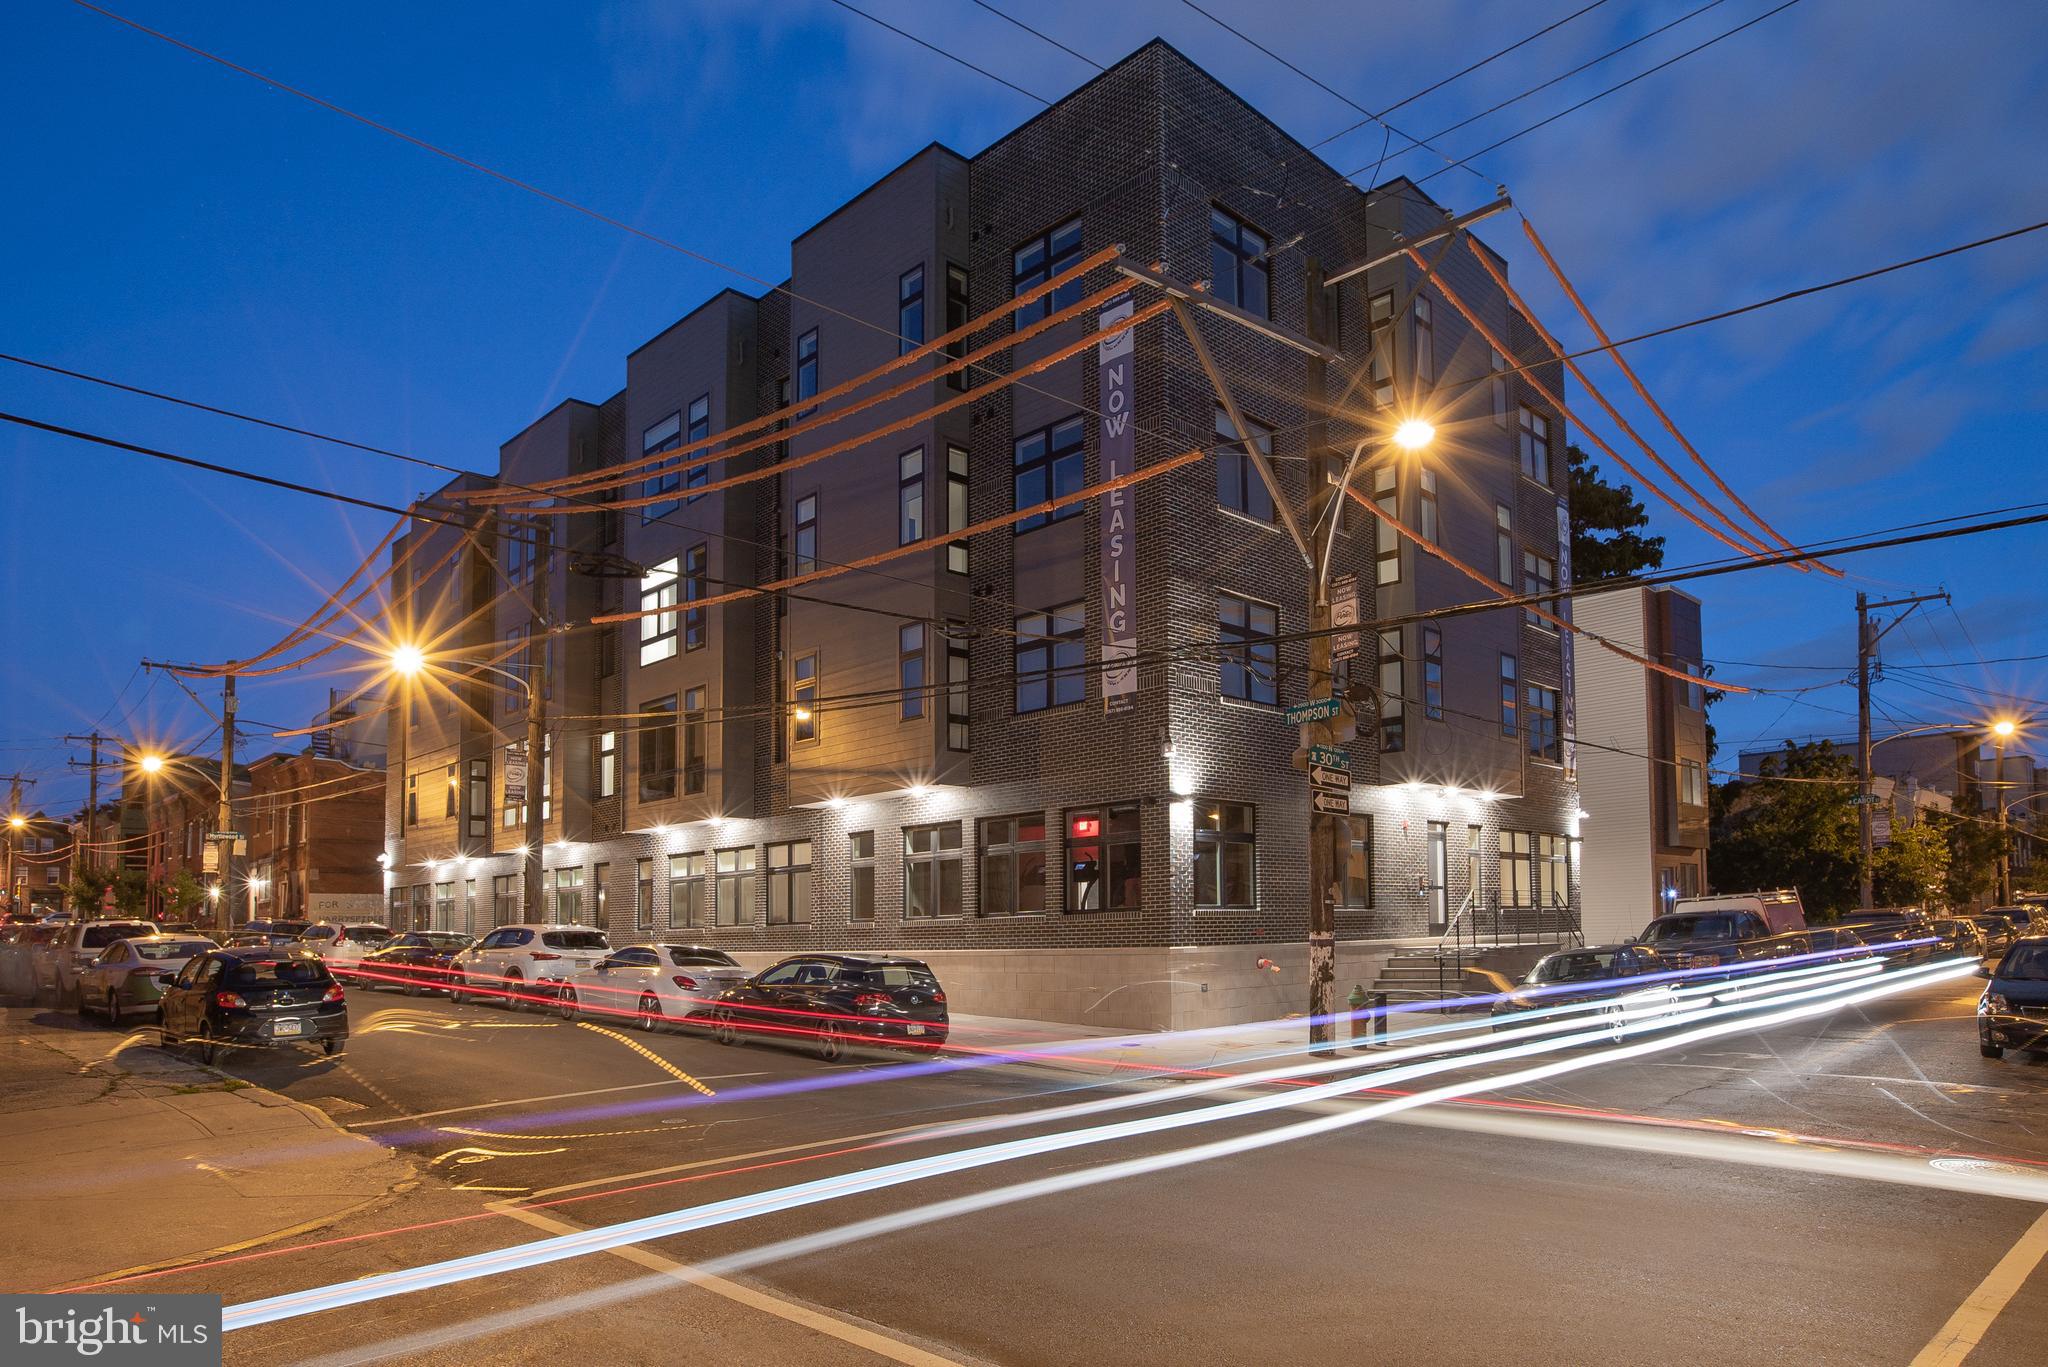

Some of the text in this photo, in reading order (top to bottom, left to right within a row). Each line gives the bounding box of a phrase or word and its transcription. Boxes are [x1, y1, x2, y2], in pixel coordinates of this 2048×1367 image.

[1104, 363, 1130, 438] NOW
[1109, 459, 1126, 633] LEASING
[1337, 586, 1353, 594] NOW
[1337, 632, 1353, 642] NOW
[1333, 640, 1359, 651] LEASING
[1286, 705, 1339, 725] THOMPSON ST
[1319, 751, 1349, 770] 30TH ST
[1321, 772, 1347, 785] ONE WAY
[1323, 798, 1346, 809] ONE WAY
[318, 901, 339, 909] FOR
